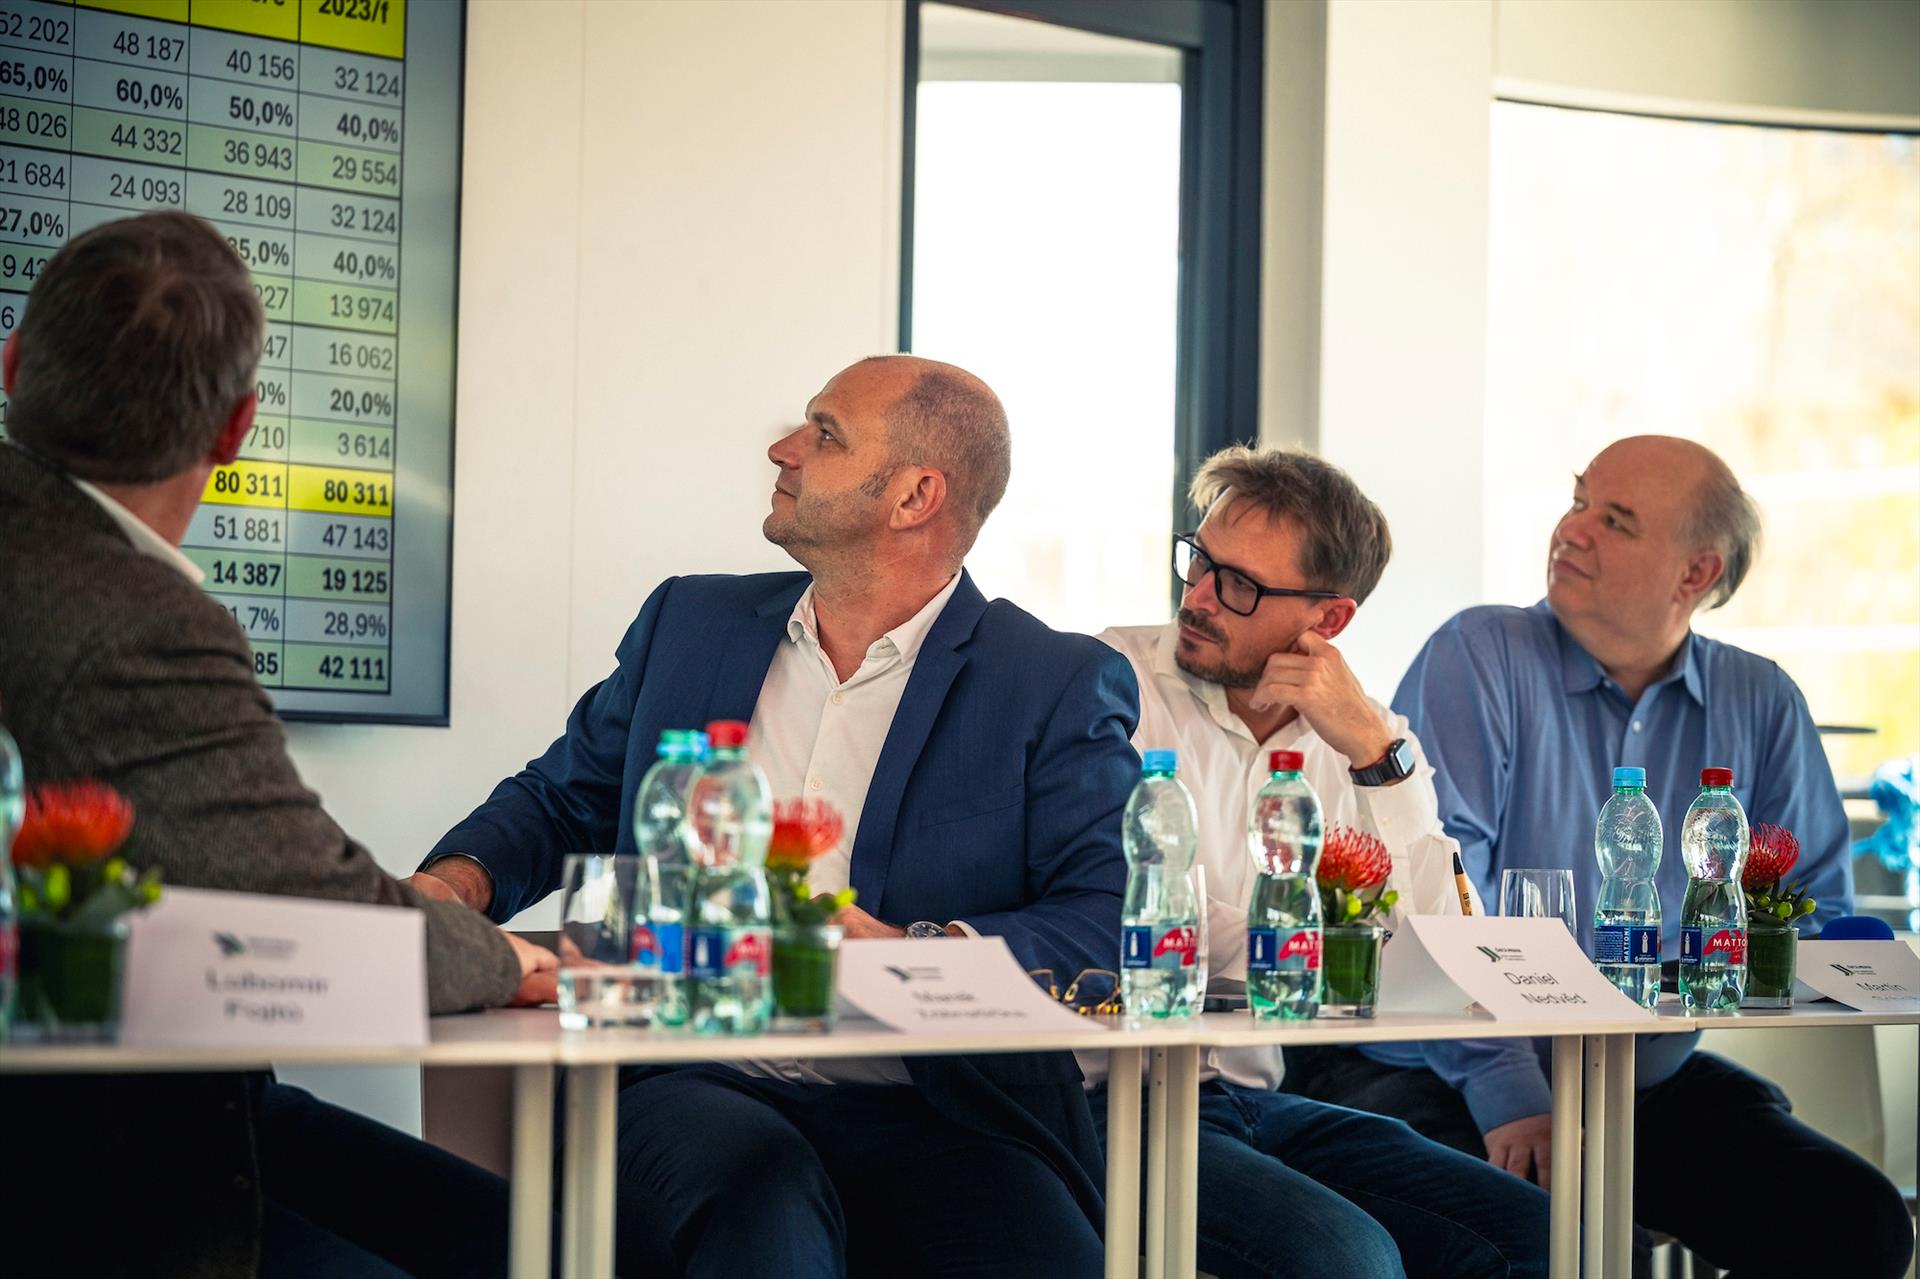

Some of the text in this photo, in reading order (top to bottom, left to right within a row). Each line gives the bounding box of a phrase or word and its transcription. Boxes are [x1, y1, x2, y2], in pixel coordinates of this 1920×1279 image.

[29, 16, 69, 45] 202
[113, 30, 185, 62] 48 187
[0, 61, 68, 93] 65,0%
[226, 49, 295, 81] 40 156
[116, 78, 183, 111] 60,0%
[334, 66, 400, 98] 32 124
[27, 111, 67, 139] 026
[229, 96, 293, 127] 50,0%
[111, 123, 182, 156] 44 332
[337, 113, 399, 143] 40,0%
[224, 139, 293, 171] 36 943
[25, 162, 66, 190] 684
[332, 155, 398, 186] 29 554
[110, 173, 181, 205] 24 093
[223, 188, 292, 220] 28 109
[331, 203, 397, 235] 32 124
[333, 250, 396, 280] 40,0%
[330, 293, 394, 322] 13 974
[263, 335, 288, 360] 47
[329, 341, 393, 371] 16 062
[256, 380, 286, 406] 0%
[330, 387, 392, 417] 20,0%
[354, 433, 390, 459] 614
[215, 470, 283, 498] 80 311
[324, 479, 389, 507] 80 311
[213, 515, 281, 544] 51 881
[322, 523, 389, 551] 47 143
[213, 559, 281, 588] 14 387
[322, 567, 388, 594] 19 125
[219, 604, 280, 632] 1,7%
[324, 611, 386, 640] 28,9%
[319, 655, 386, 682] 42 111
[1503, 972, 1560, 985] Daniel
